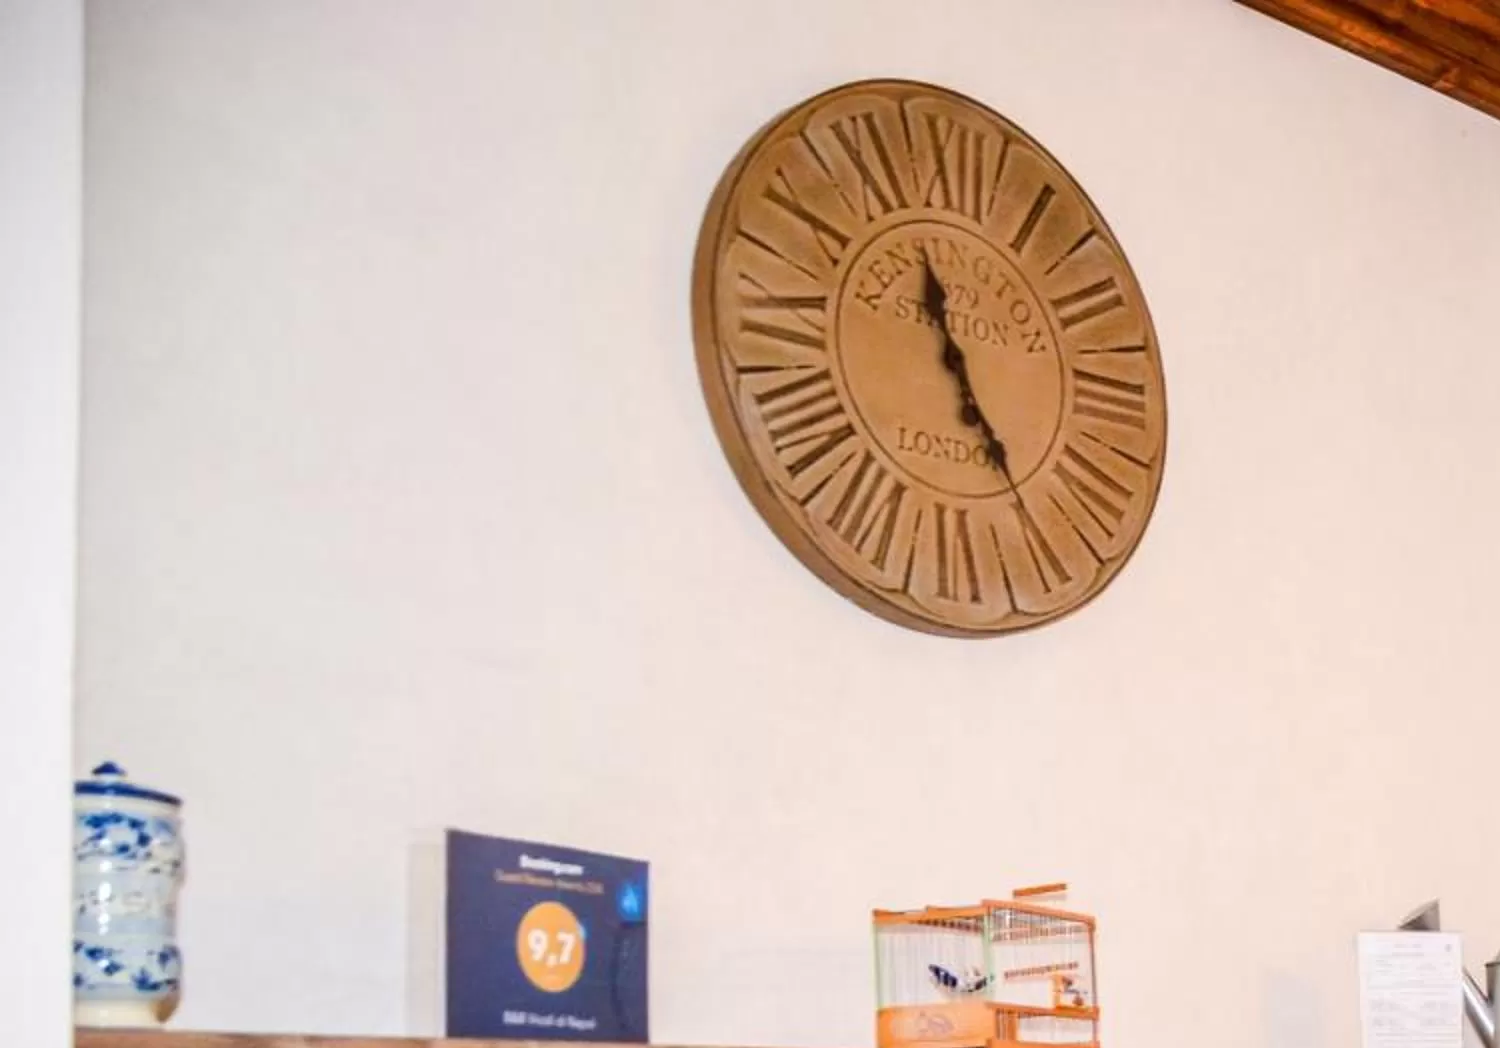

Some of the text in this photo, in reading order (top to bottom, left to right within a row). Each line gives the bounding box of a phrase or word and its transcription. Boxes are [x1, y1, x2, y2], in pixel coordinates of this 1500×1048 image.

[829, 112, 909, 223] XI
[922, 112, 988, 226] XII
[762, 166, 853, 268] X
[1008, 182, 1057, 255] I
[894, 293, 1010, 347] STTION
[1050, 275, 1126, 332] II
[896, 426, 1003, 473] LONDO
